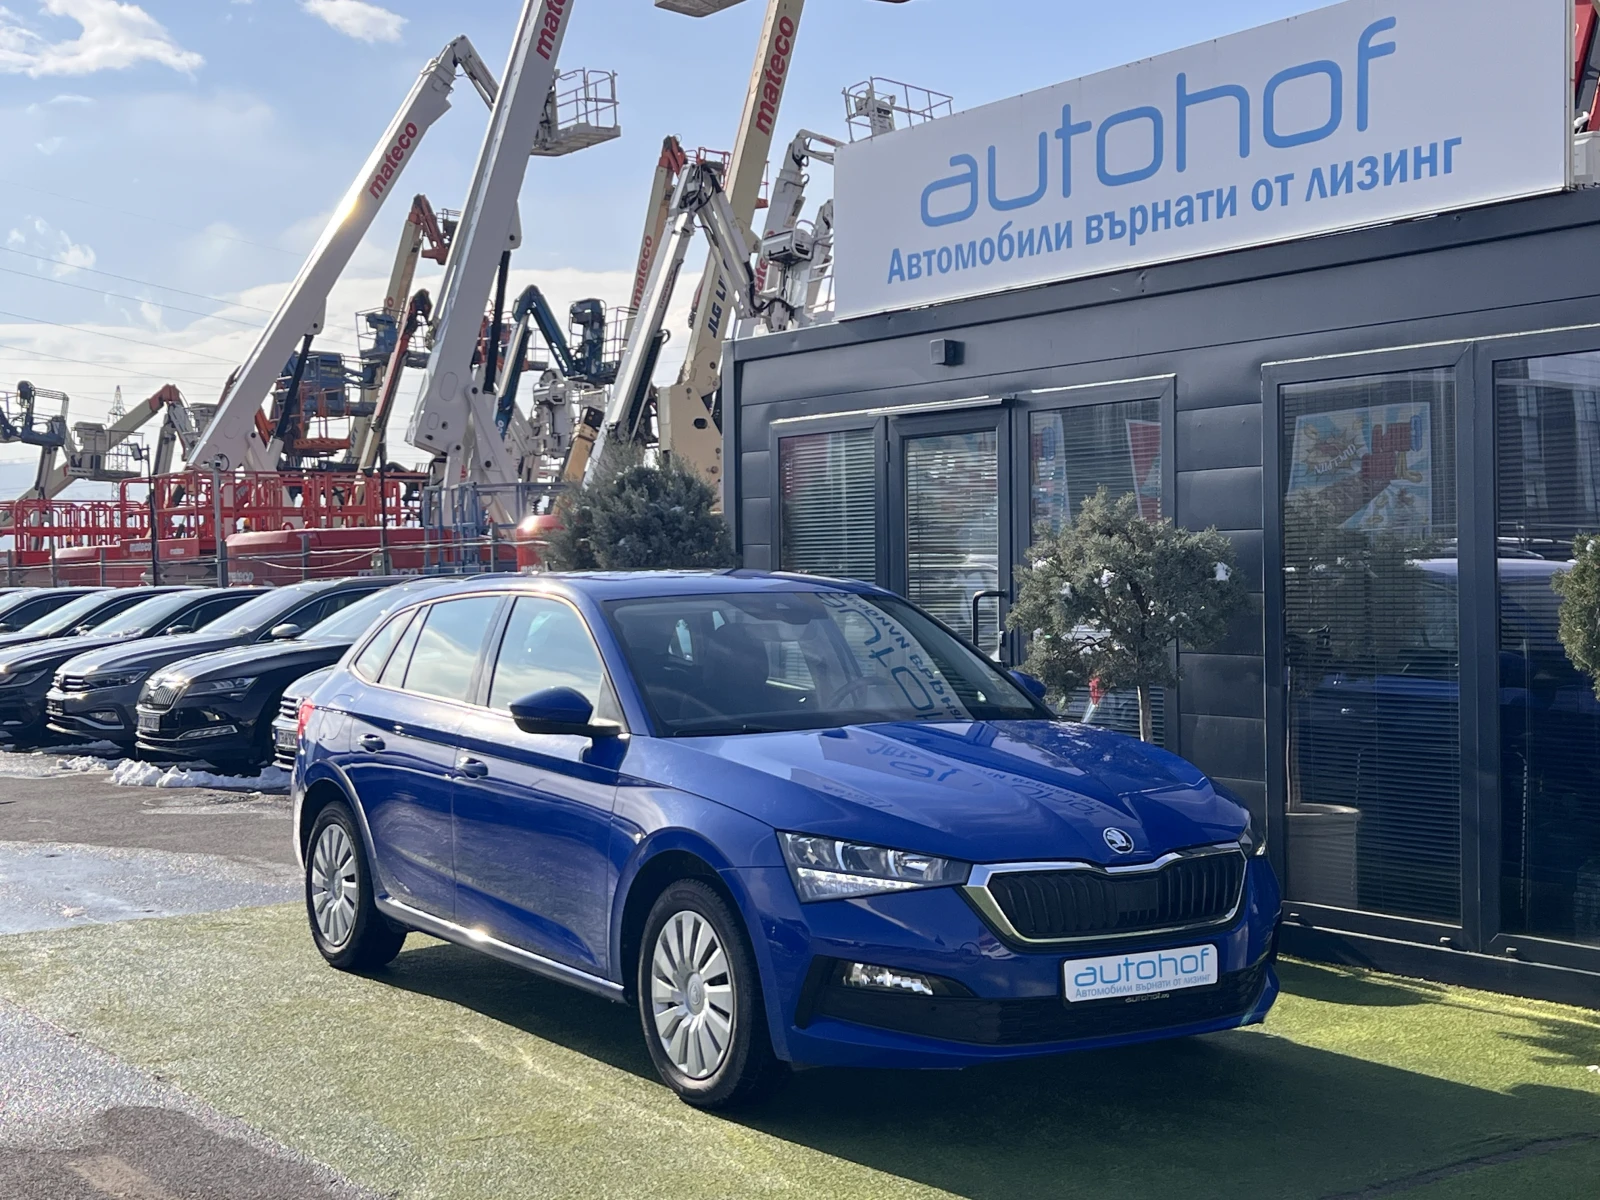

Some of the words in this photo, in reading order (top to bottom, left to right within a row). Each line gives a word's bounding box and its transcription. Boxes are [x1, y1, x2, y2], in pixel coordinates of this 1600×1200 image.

[536, 0, 567, 60] mat
[757, 16, 794, 136] mateco
[921, 16, 1396, 226] autohof
[369, 122, 417, 199] mateco
[888, 221, 1072, 283] Автомобили
[1086, 186, 1236, 245] върнати
[1251, 173, 1294, 211] от
[1306, 137, 1462, 201] лизинг
[633, 235, 652, 307] mateco
[708, 302, 722, 339] JLG
[1074, 948, 1209, 987] autohof
[1076, 983, 1133, 998] Автомобили
[1135, 979, 1171, 992] върнати
[1173, 977, 1181, 986] от
[1183, 974, 1211, 985] лизинг
